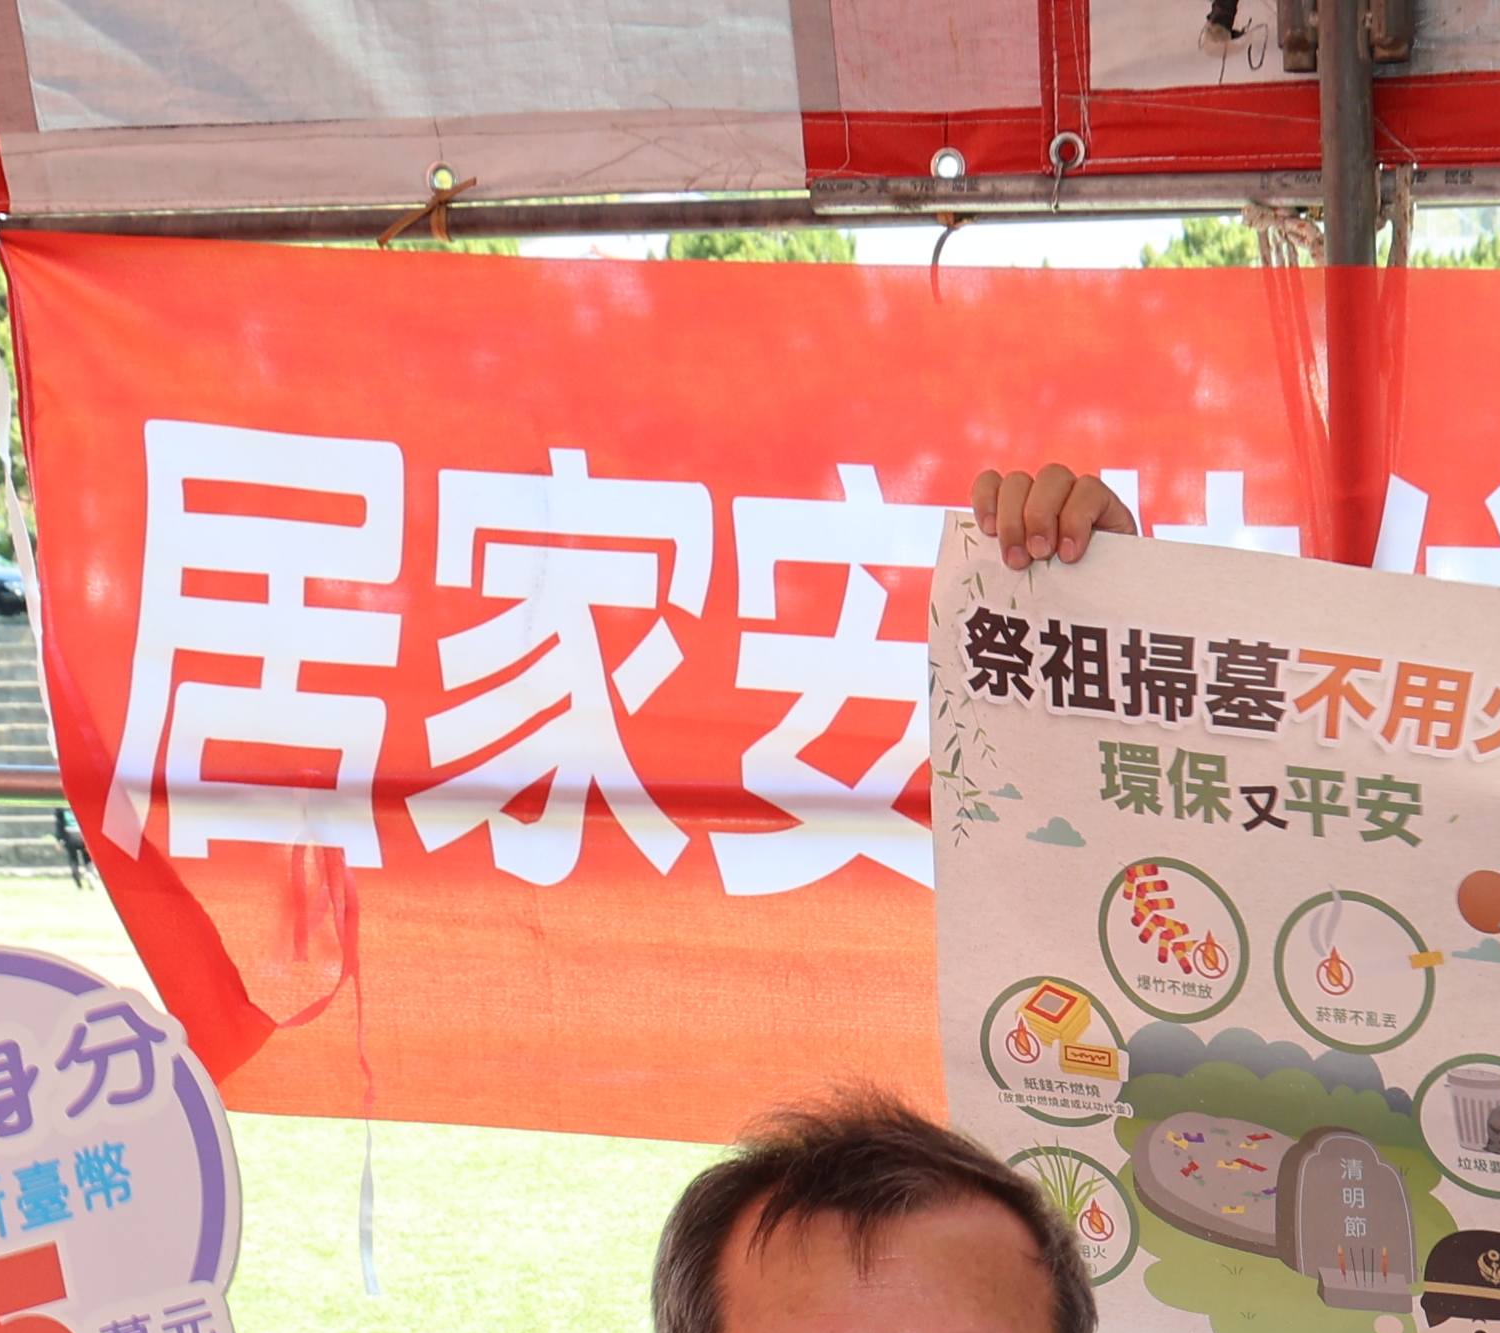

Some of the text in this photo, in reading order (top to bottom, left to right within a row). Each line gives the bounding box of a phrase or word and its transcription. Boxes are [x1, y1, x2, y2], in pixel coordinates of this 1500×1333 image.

[1098, 738, 1424, 848] 環保又平安
[1136, 974, 1214, 1000] 爆竹不燃放
[1315, 1004, 1398, 1030] 菸蒂不亂丟
[1023, 1076, 1101, 1098] 紙錢不燃燒
[1340, 1156, 1367, 1240] 清明節
